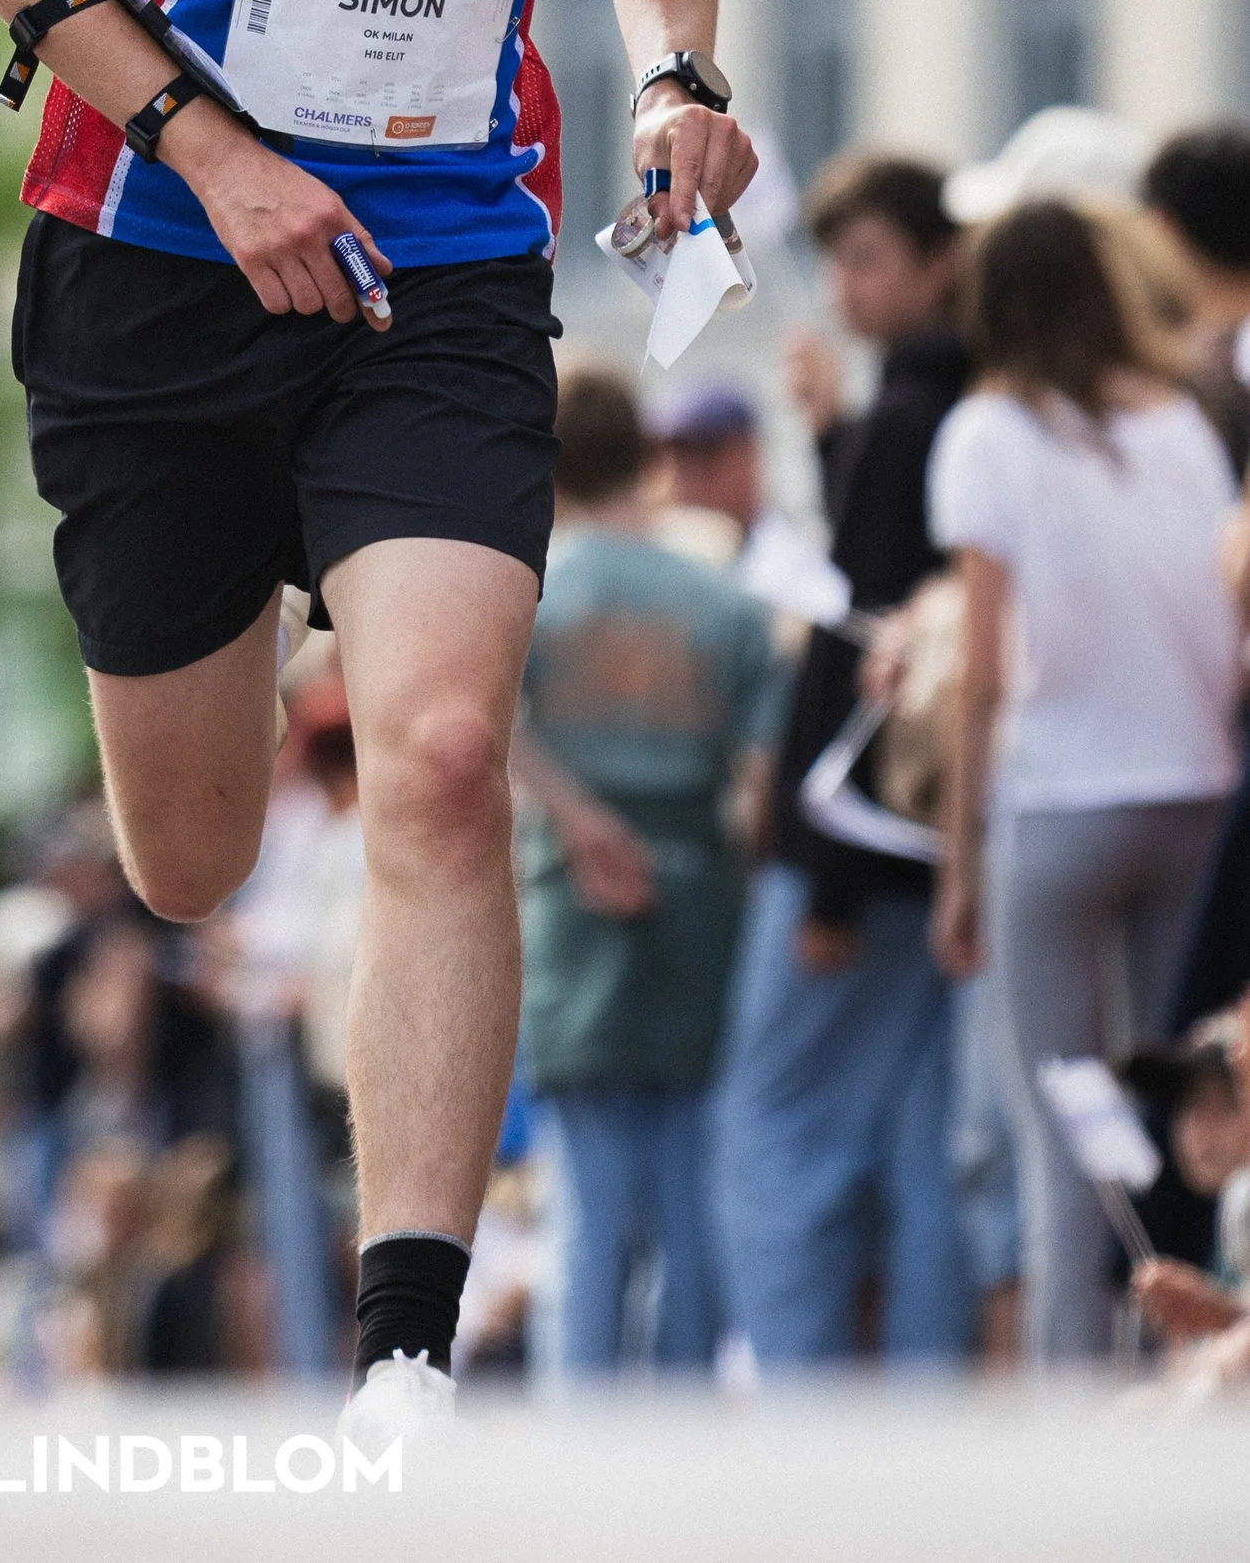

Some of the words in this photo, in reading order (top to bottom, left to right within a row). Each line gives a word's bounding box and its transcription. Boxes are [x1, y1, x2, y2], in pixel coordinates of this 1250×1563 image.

[363, 29, 380, 40] OK
[382, 31, 414, 42] MILAN
[364, 49, 383, 61] H18
[385, 51, 405, 61] ELIT
[294, 106, 372, 127] CHALMERS
